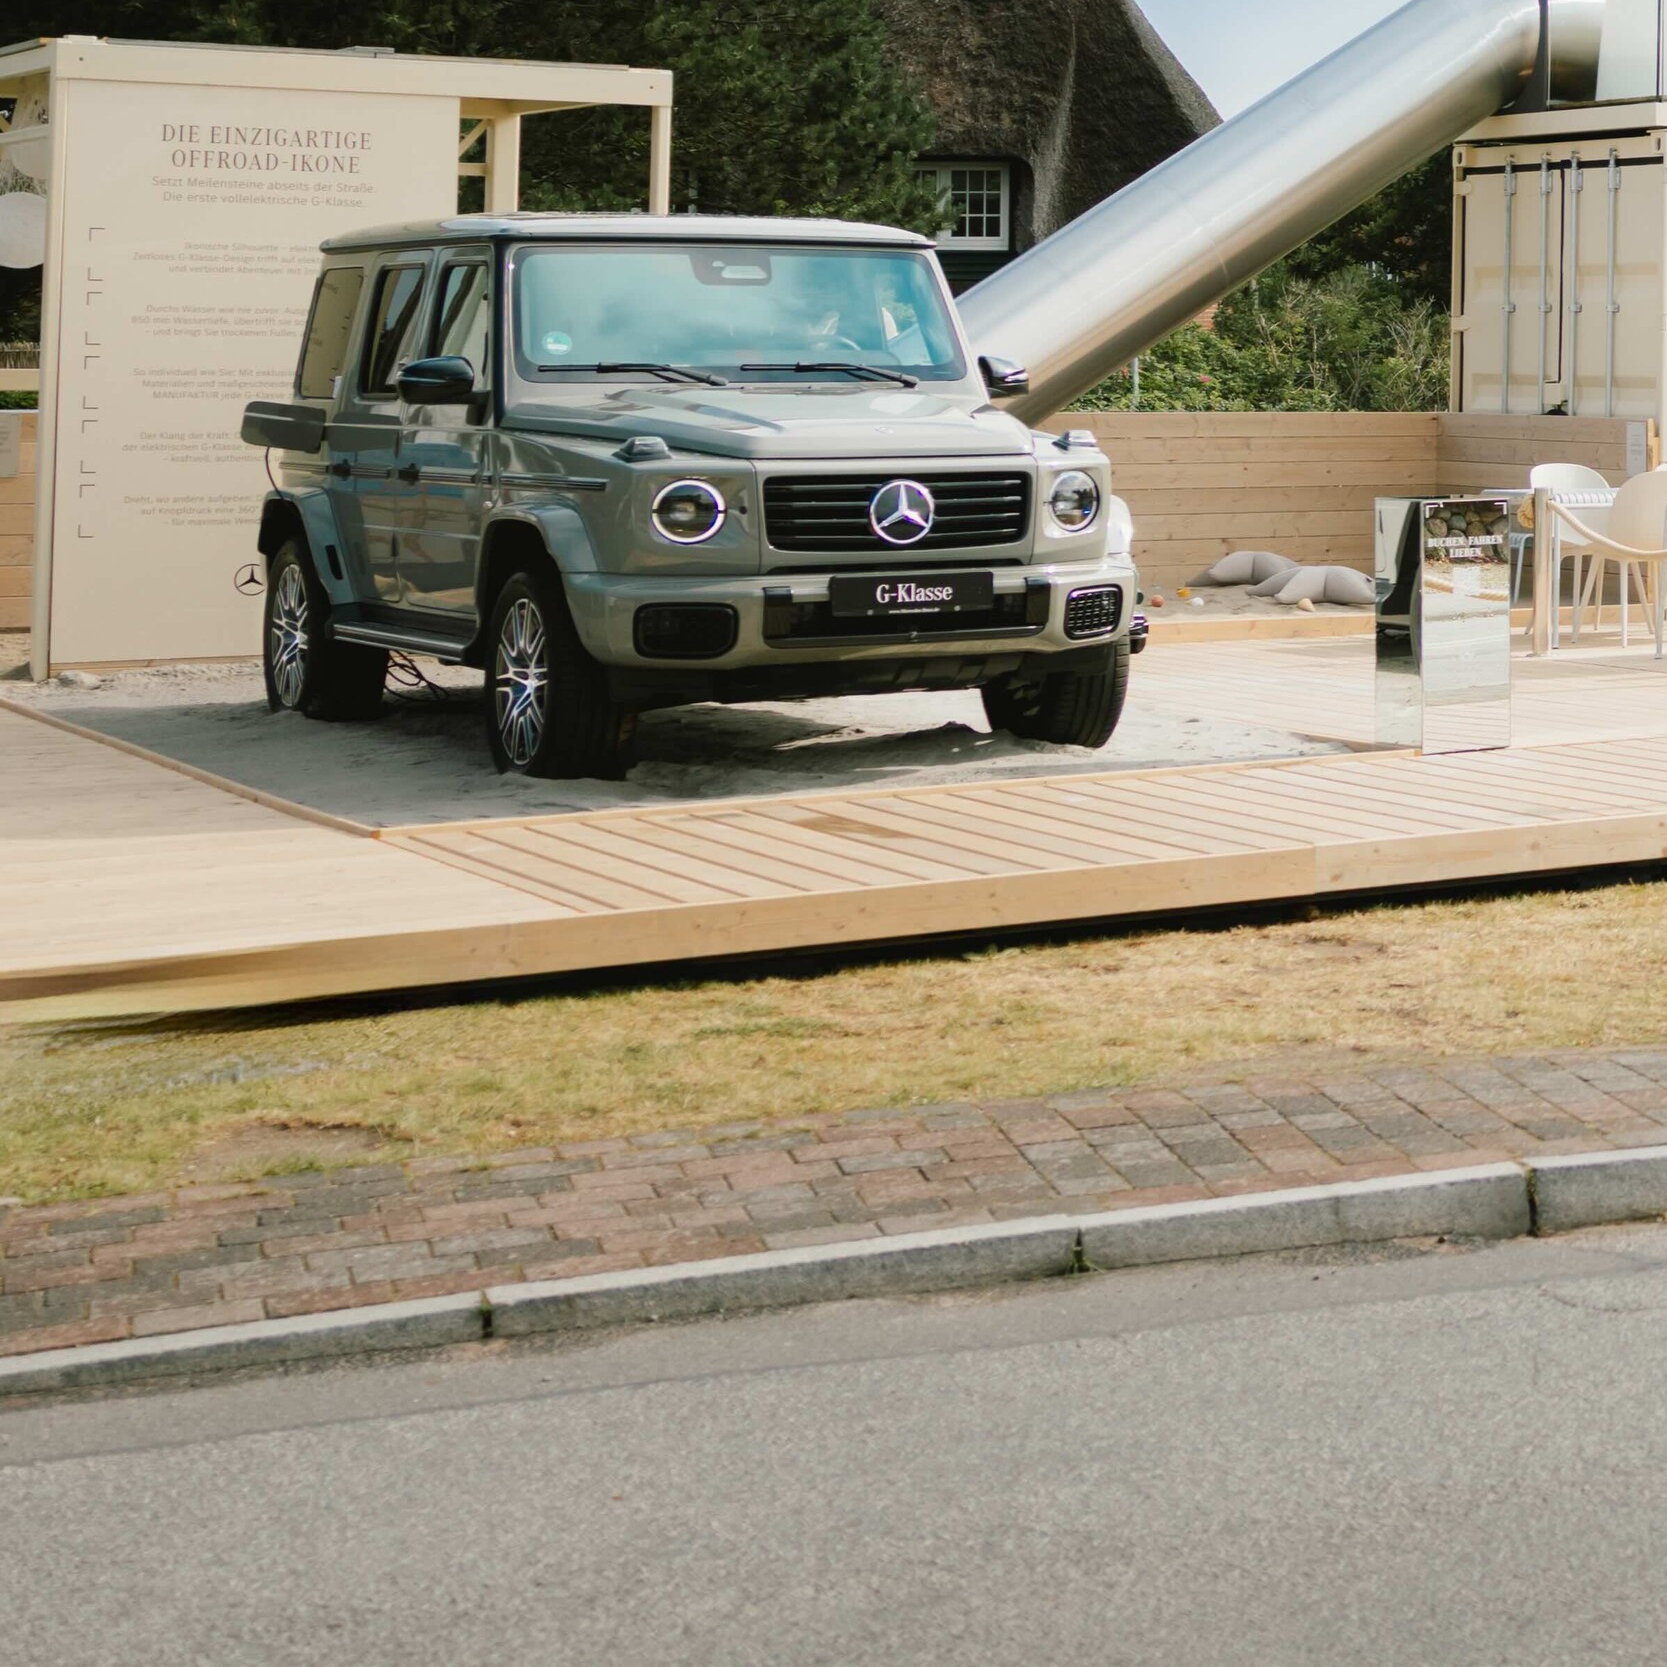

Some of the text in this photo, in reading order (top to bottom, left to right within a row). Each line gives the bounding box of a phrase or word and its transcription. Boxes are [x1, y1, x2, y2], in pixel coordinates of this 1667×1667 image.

[162, 124, 372, 150] DIE EINZIGARTIGE
[171, 149, 361, 174] OFFROAD-IKONE
[152, 176, 182, 187] Setzt
[187, 177, 263, 190] Meilensteine
[267, 180, 309, 191] abseits
[313, 182, 333, 192] der
[163, 191, 183, 202] Die
[187, 193, 218, 203] erste
[221, 193, 307, 206] vollelektrische
[876, 583, 953, 604] G-Klasse
